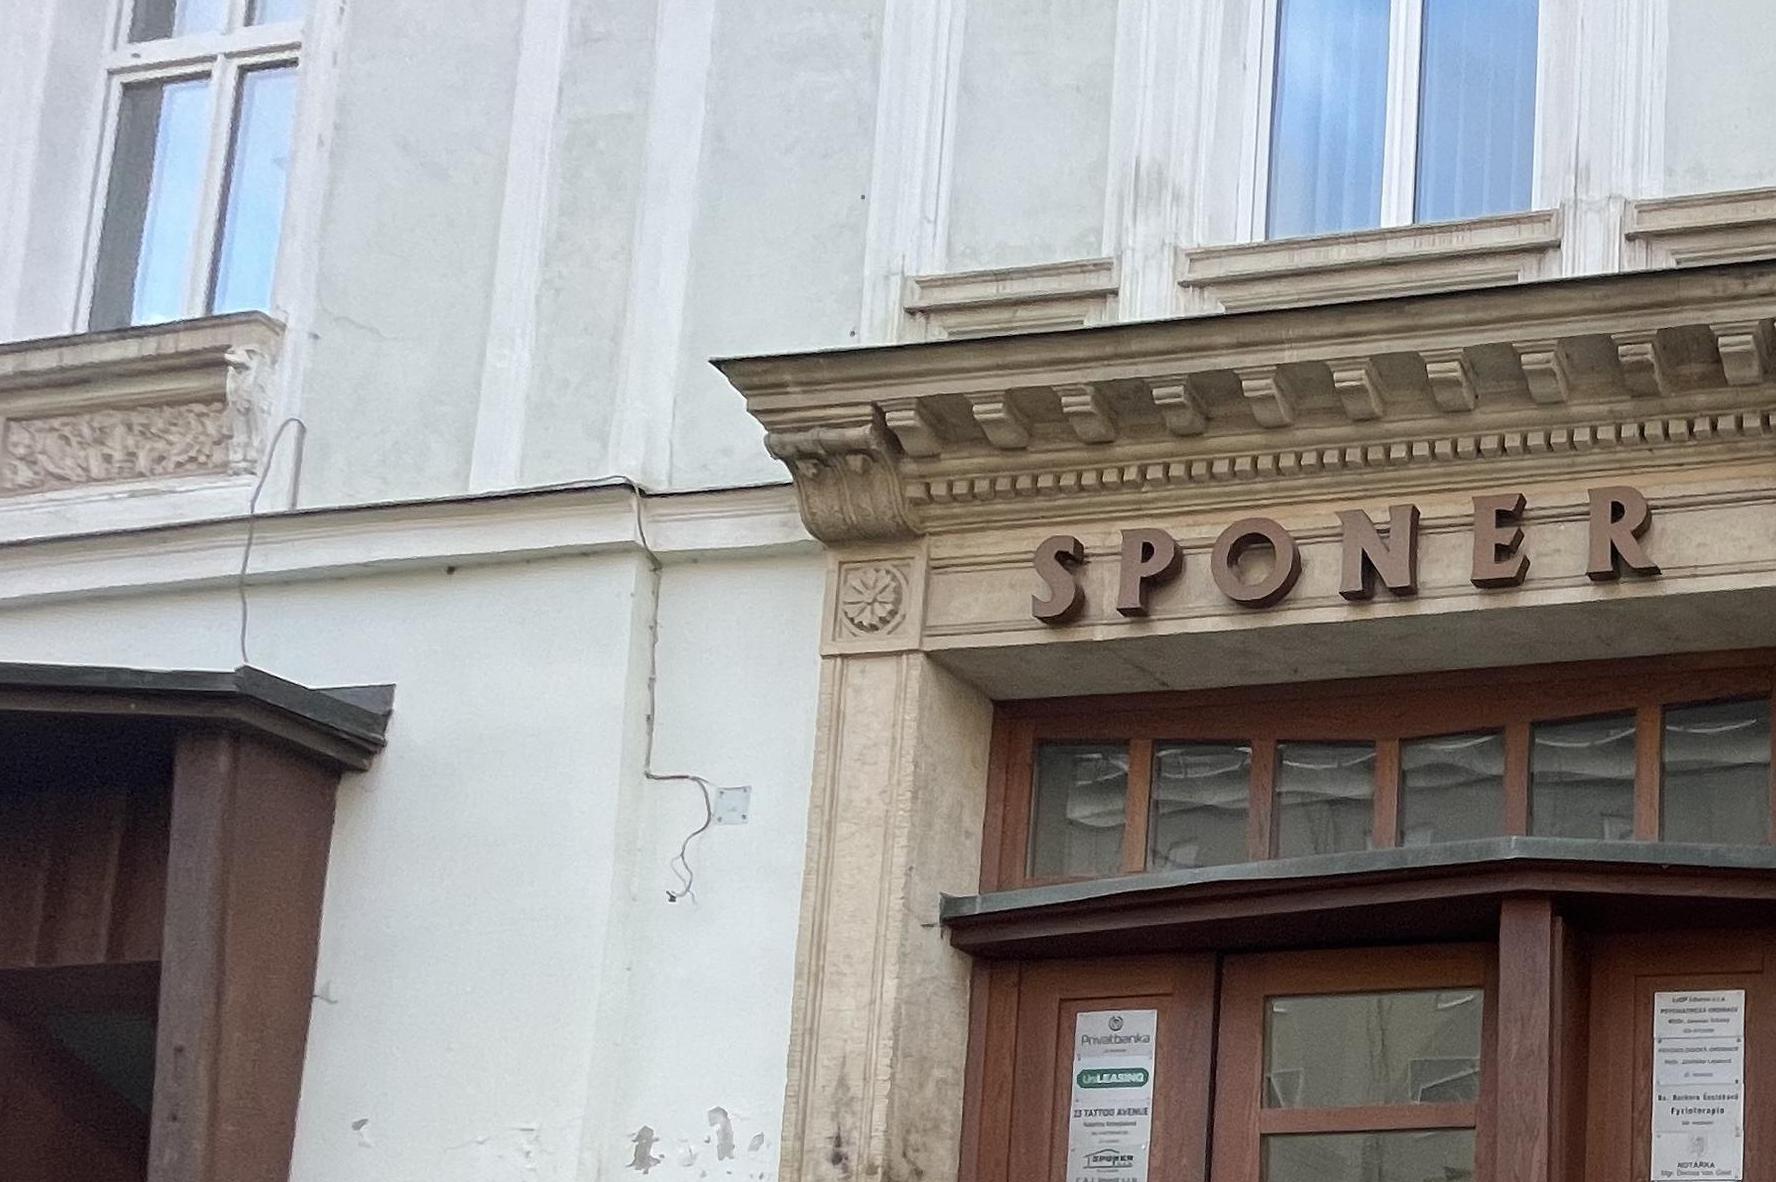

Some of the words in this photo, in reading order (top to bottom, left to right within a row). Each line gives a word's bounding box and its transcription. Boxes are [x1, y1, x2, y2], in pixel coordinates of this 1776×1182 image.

[1032, 486, 1662, 626] SPONER
[1081, 1033, 1150, 1046] Privatbanka
[1117, 1107, 1148, 1115] AVENUE
